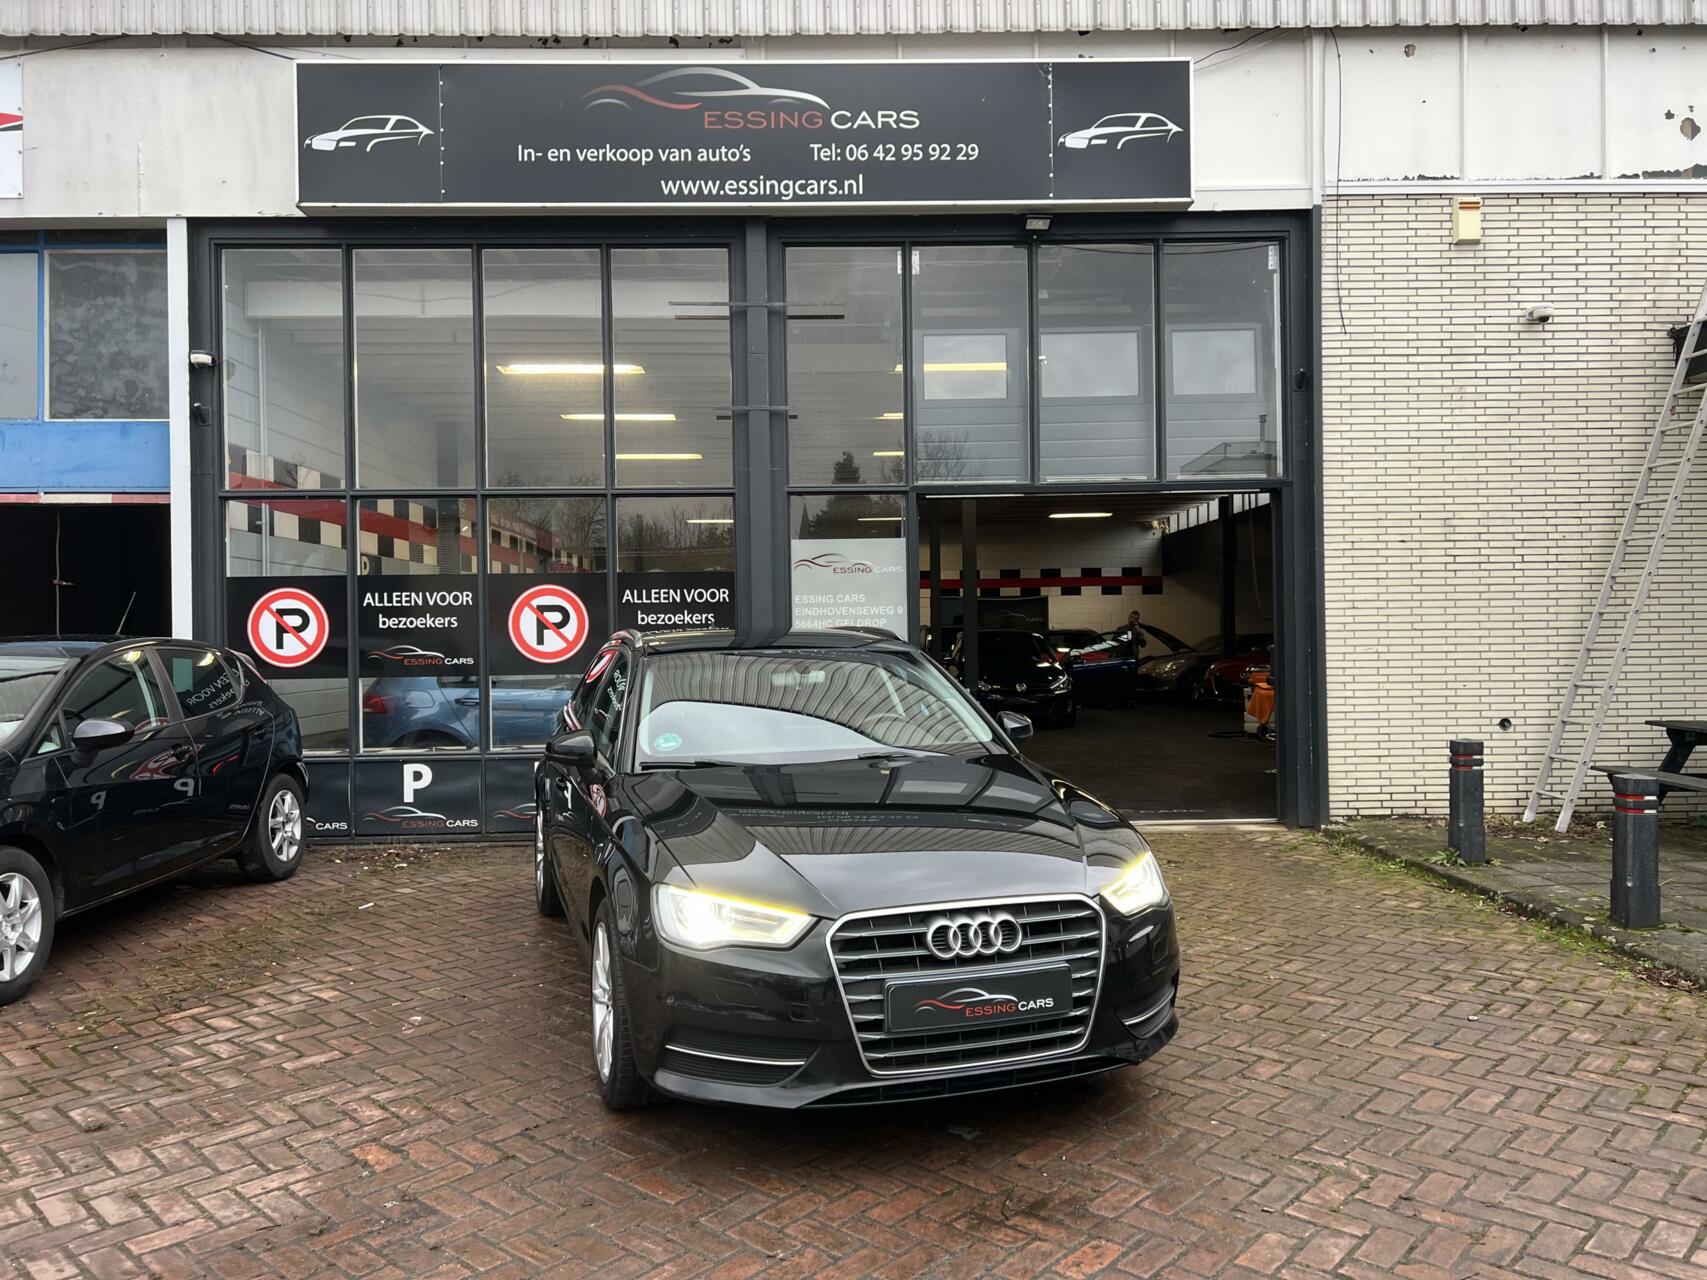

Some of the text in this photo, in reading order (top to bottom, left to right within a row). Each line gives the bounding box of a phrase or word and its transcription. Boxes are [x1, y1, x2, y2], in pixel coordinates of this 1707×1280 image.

[704, 111, 920, 129] ESSING CARS
[519, 145, 542, 161] In-
[548, 149, 570, 161] en
[576, 144, 653, 165] verkoop
[658, 149, 691, 161] van
[810, 143, 978, 161] Tel: 06 42 95 92 29
[661, 174, 863, 200] www.essingcars.nl
[363, 592, 472, 606] ALLEEN VOOR
[623, 589, 729, 603] ALLEEN VOOR
[795, 594, 866, 603] ESSING CARS
[638, 611, 714, 624] bezoekers
[795, 606, 894, 615] EINDHOVENSEWEG
[379, 613, 457, 628] bezoekers
[445, 657, 474, 665] CARS
[404, 764, 432, 802] P
[316, 822, 348, 830] CARS
[402, 819, 478, 828] ESSING CARS
[965, 997, 1054, 1017] ESSING CARS
